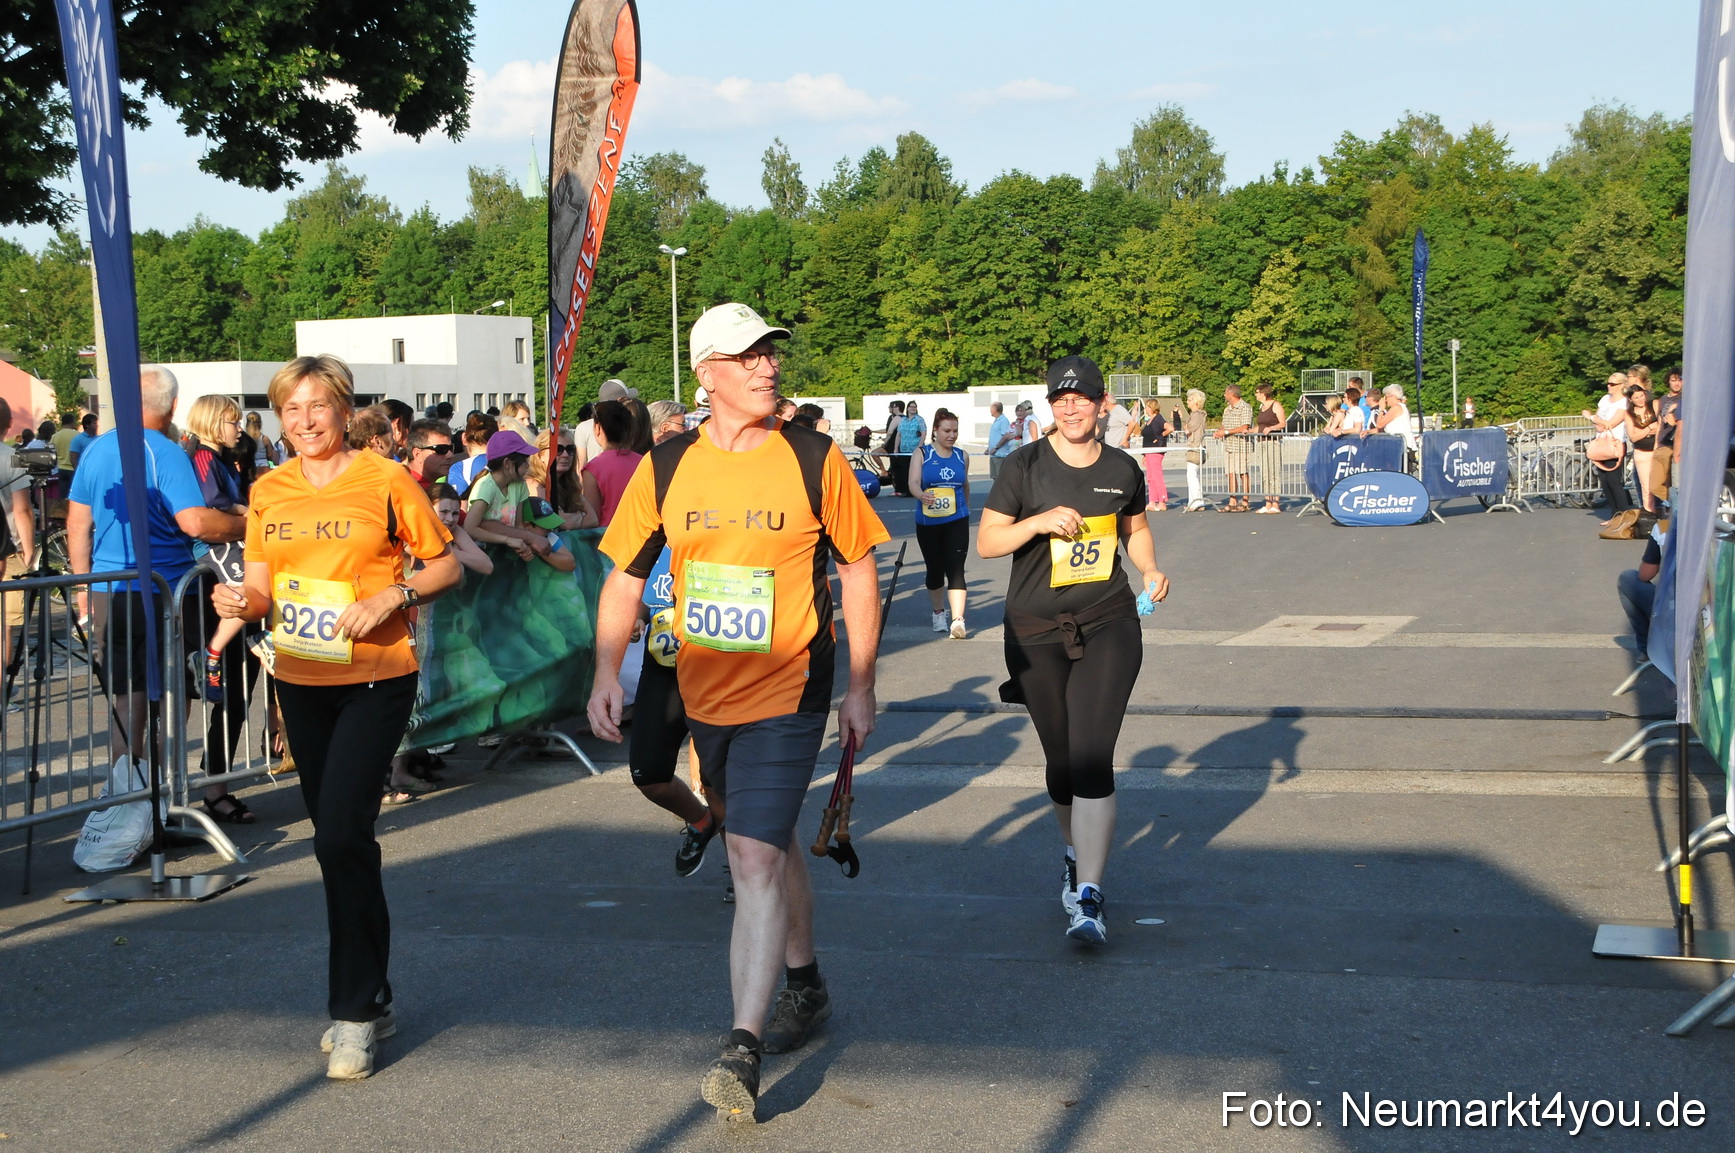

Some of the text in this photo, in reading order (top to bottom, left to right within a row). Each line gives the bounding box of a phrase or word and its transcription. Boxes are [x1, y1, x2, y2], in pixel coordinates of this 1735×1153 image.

[1334, 461, 1382, 480] Fisch
[1453, 456, 1496, 477] Fischer
[1457, 477, 1492, 488] AUTOMOBILE
[1353, 494, 1417, 508] Fischer
[1359, 507, 1413, 515] AUTOMOBILE
[1069, 540, 1101, 568] 85
[282, 603, 338, 642] 926
[686, 601, 767, 642] 5030
